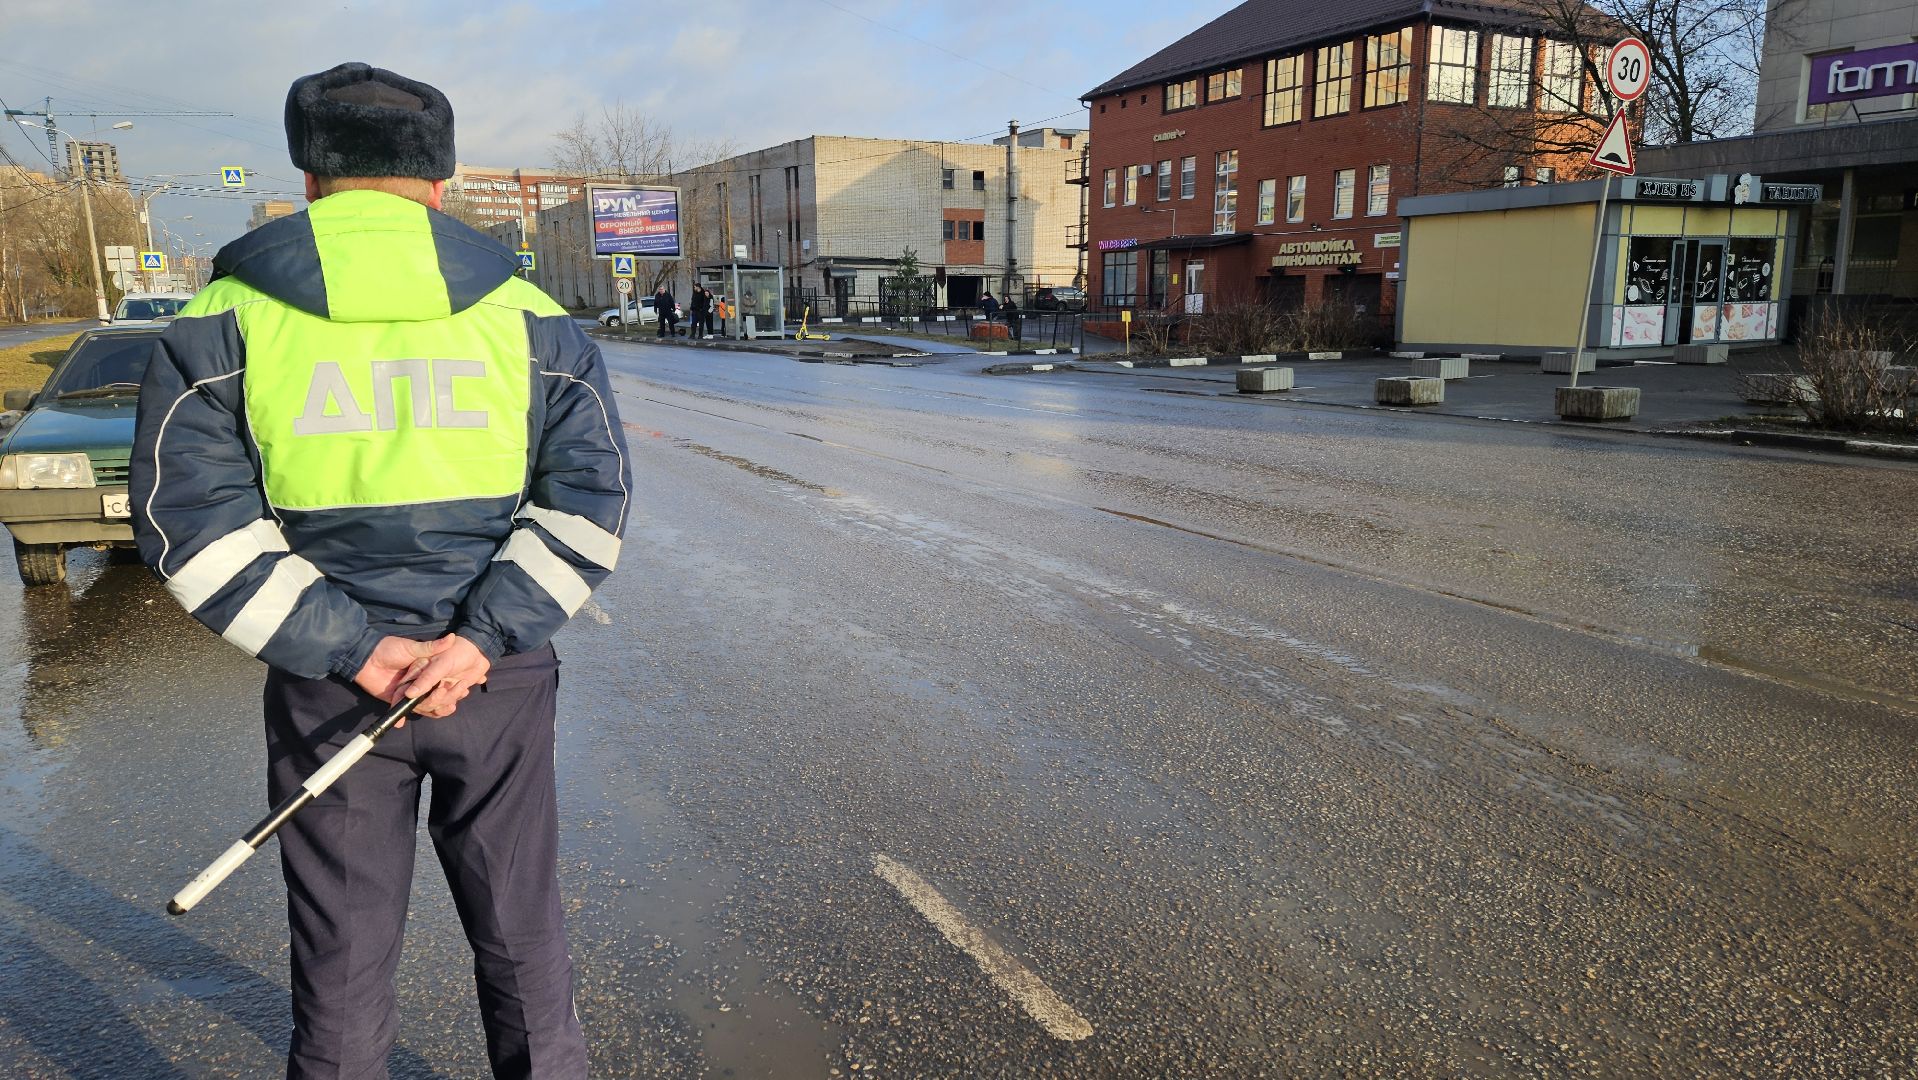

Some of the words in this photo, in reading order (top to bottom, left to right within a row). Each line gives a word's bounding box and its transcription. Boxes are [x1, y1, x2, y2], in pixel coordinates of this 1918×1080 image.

[1617, 56, 1641, 83] 30
[1827, 59, 1918, 94] fam
[1643, 181, 1678, 197] ХЛЕБ
[1768, 186, 1820, 201] ТАНДЫРА
[613, 209, 651, 218] МЕБЕЛЬНЫЙ
[651, 208, 670, 216] ЦЕНТР
[599, 218, 642, 229] ОГРОМНЫЙ
[618, 226, 645, 235] ВЫБОР
[645, 223, 675, 232] МЕБЕЛИ
[1279, 237, 1355, 255] АВТОМОЙКА
[1272, 252, 1363, 267] ШИНОМОНТАЖ
[619, 281, 629, 290] 20
[293, 358, 489, 436] ДПС
